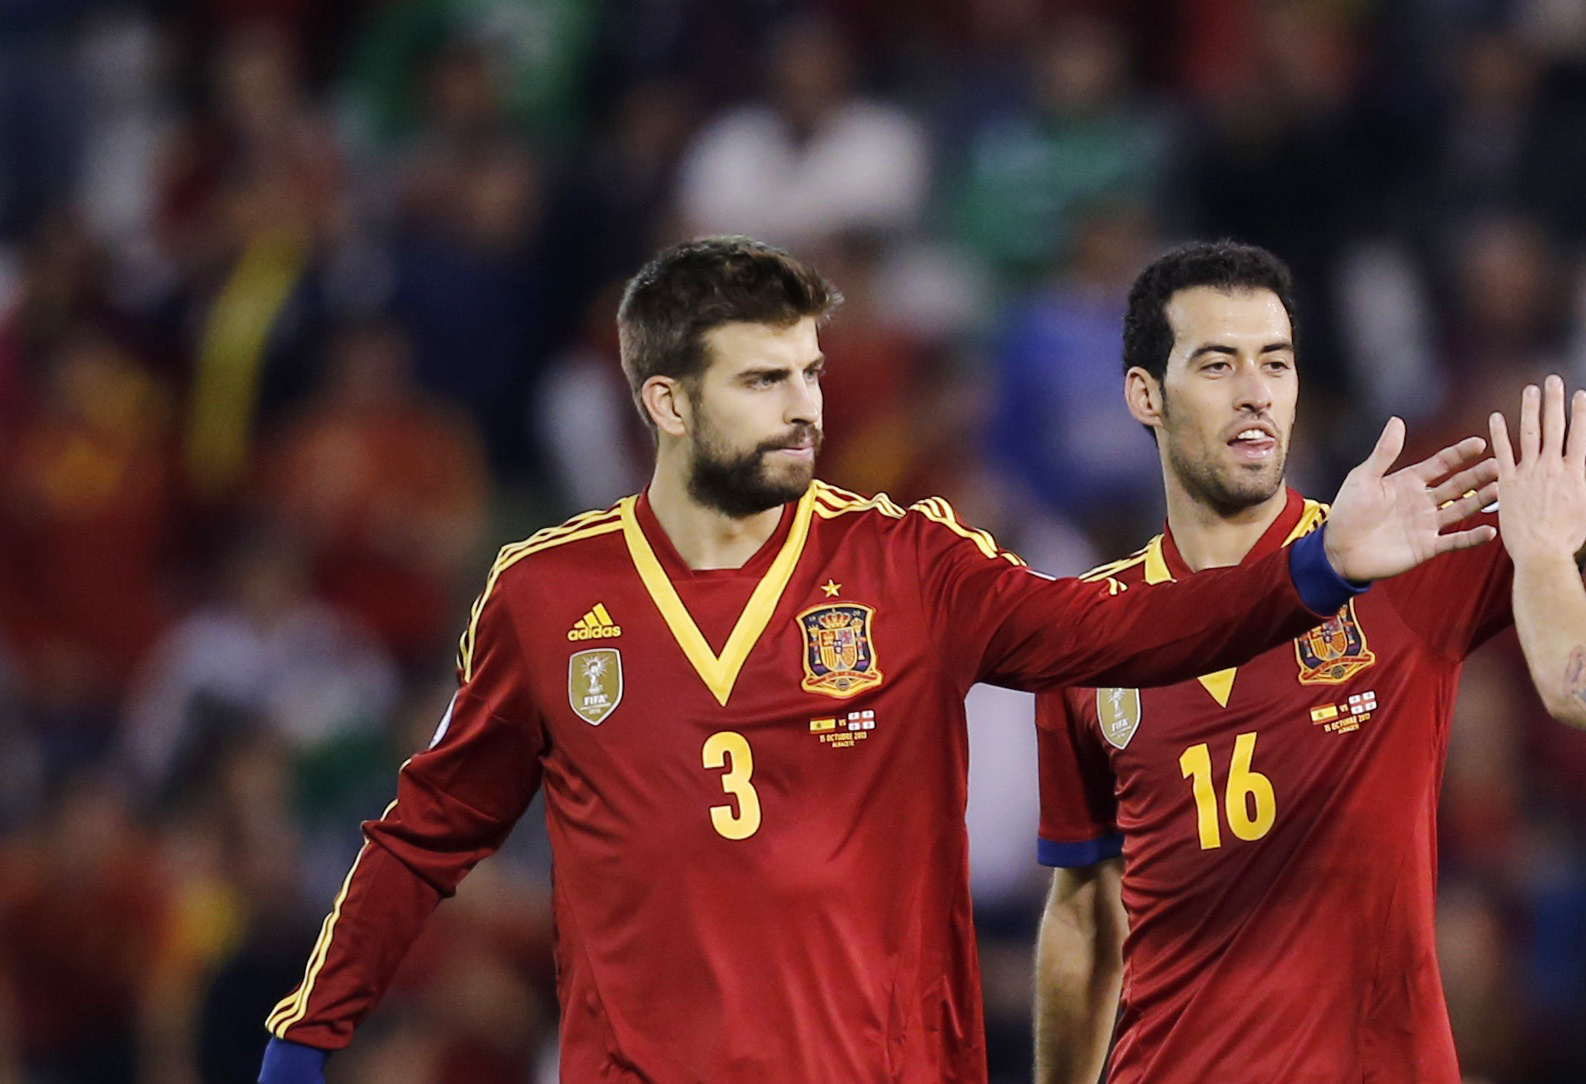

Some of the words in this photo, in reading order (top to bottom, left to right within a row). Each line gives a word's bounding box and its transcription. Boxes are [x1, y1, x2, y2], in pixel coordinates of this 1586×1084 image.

[567, 624, 622, 641] adidas
[702, 731, 762, 840] 3
[1179, 731, 1277, 850] 16
